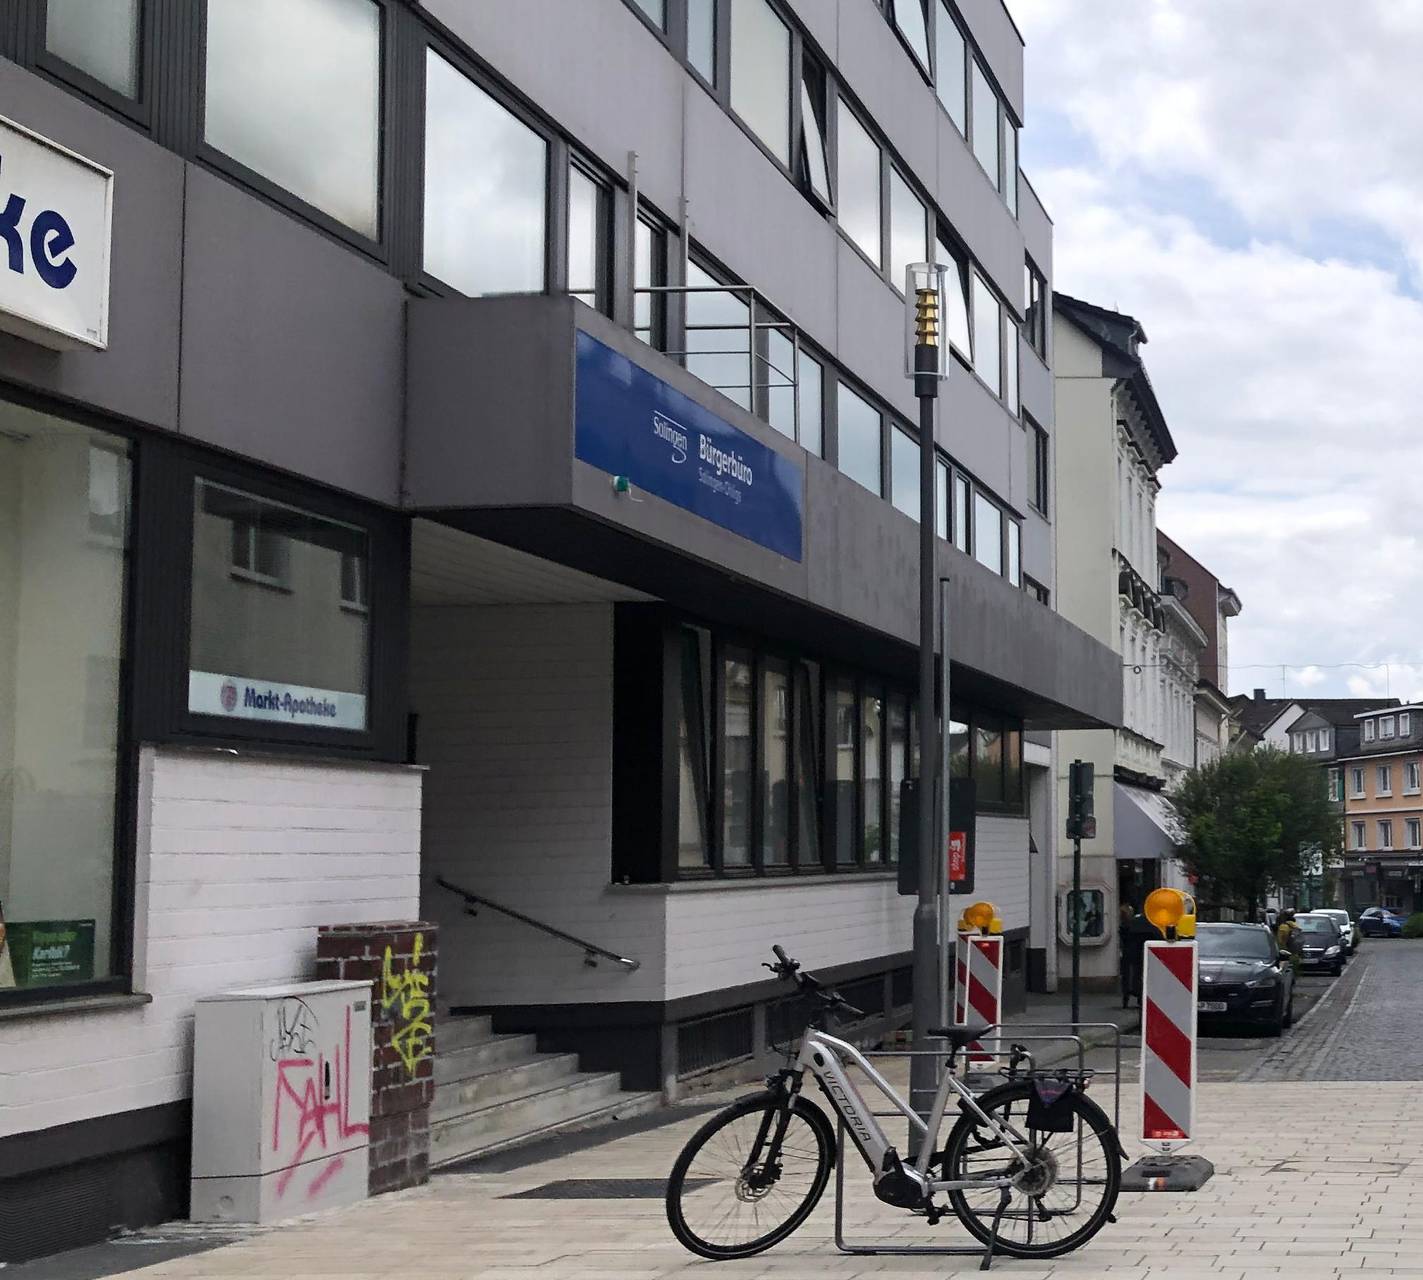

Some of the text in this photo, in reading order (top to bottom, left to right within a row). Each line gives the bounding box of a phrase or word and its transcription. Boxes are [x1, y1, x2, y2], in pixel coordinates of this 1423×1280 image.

[653, 411, 688, 463] Solingen
[699, 434, 752, 486] Bürgerbüro
[244, 686, 337, 718] Markt-Apotheke
[824, 1071, 872, 1141] VICTORIA
